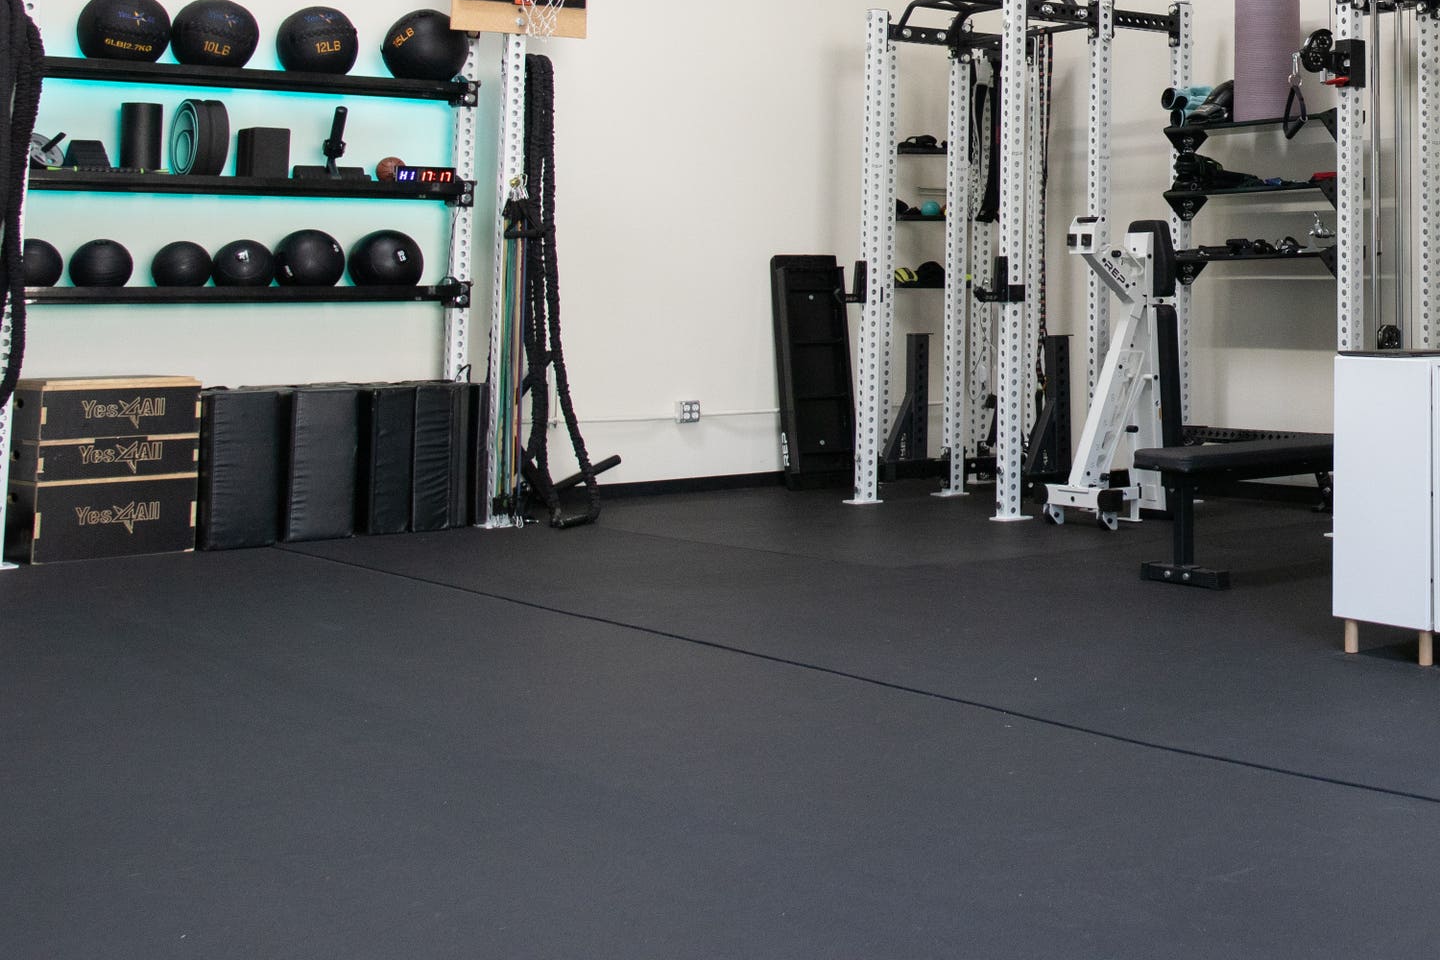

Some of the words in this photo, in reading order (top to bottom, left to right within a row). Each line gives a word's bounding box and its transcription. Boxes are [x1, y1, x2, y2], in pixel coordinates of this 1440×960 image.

[392, 27, 415, 48] 15LB
[203, 40, 231, 56] 10LB
[315, 40, 342, 54] 12LB
[421, 170, 452, 182] 17:17
[1103, 260, 1126, 284] REP
[781, 431, 790, 467] REP
